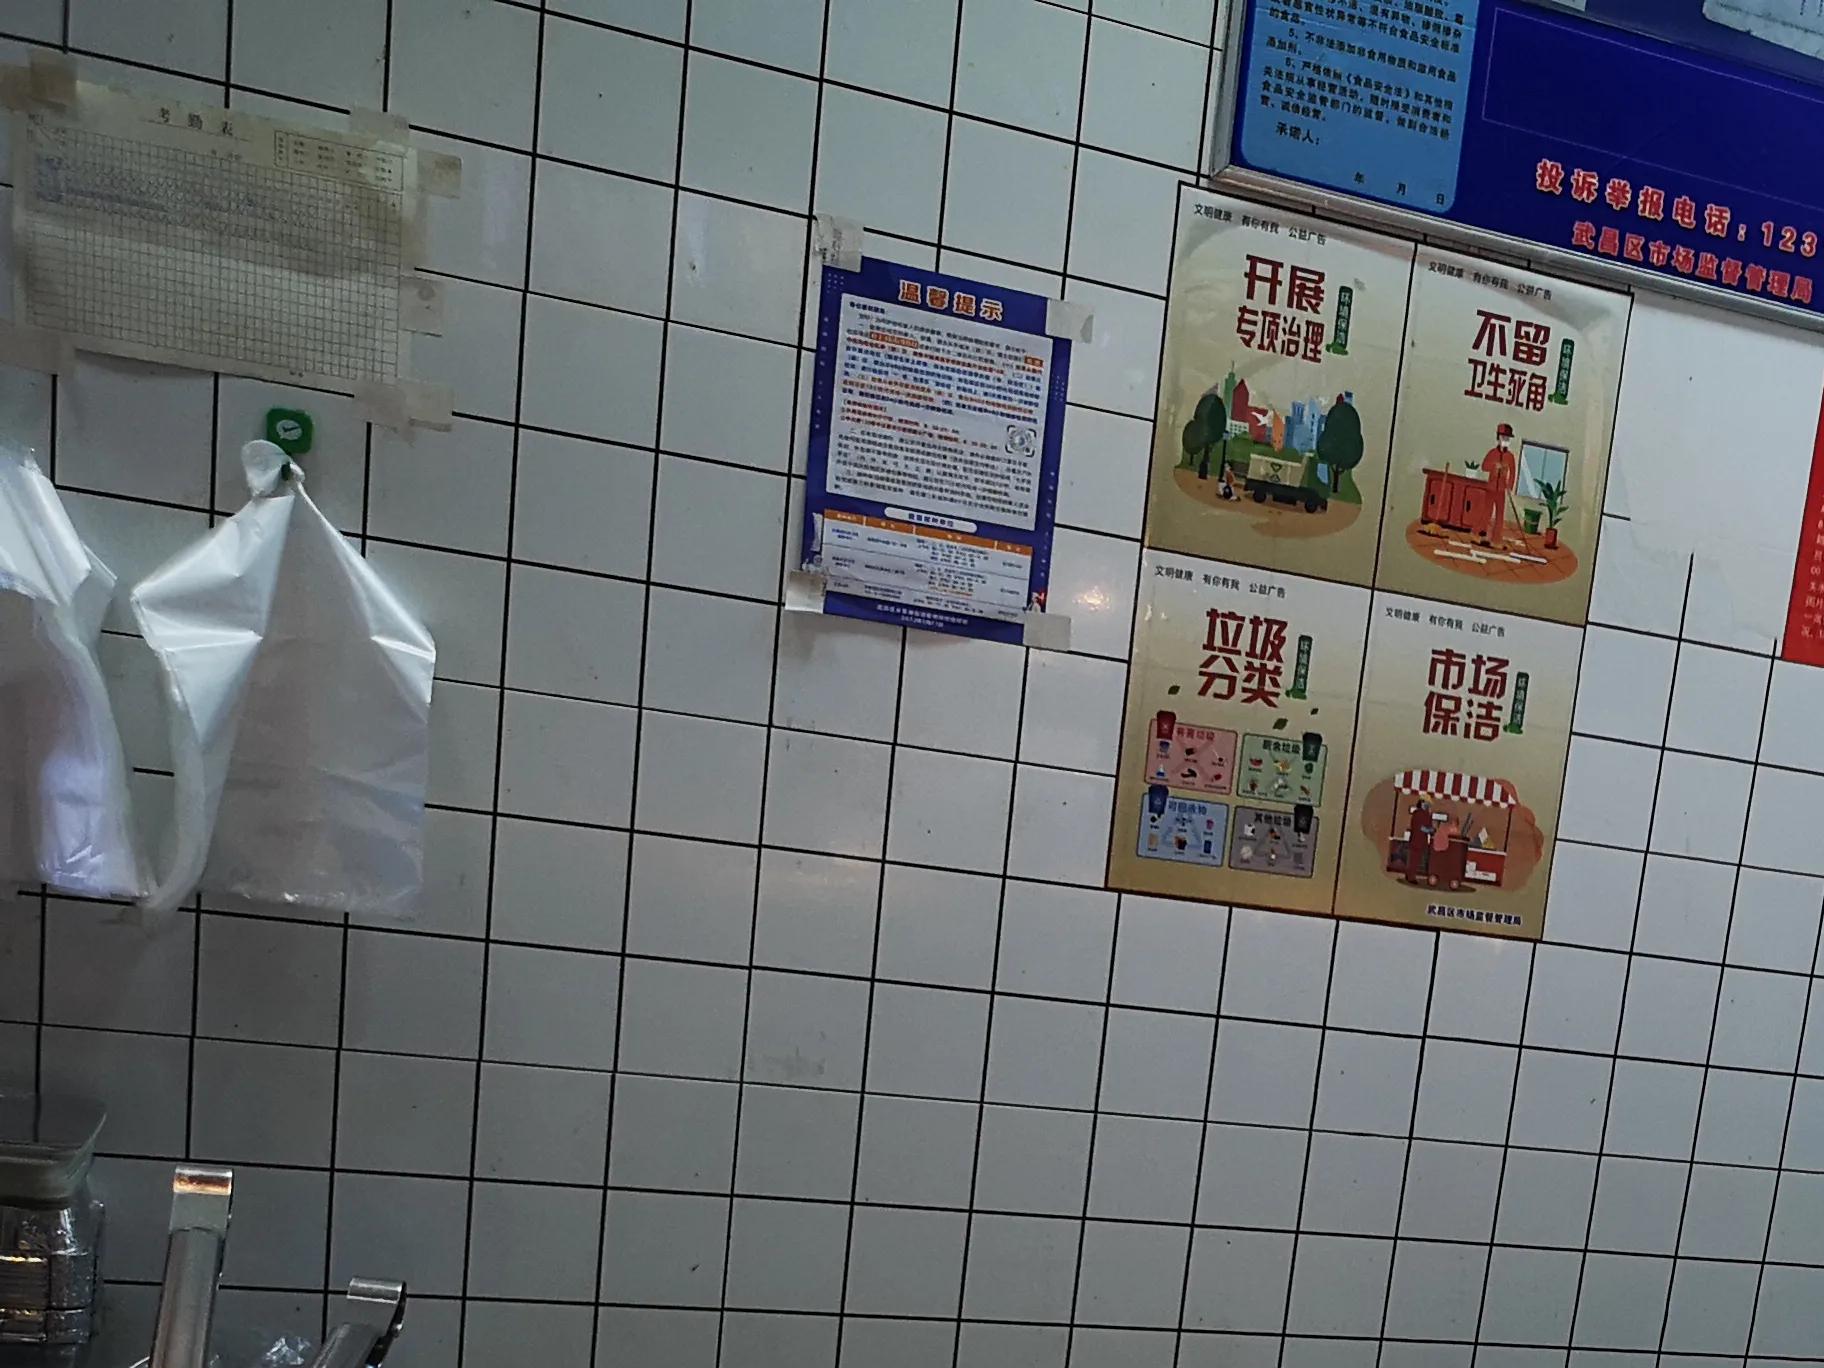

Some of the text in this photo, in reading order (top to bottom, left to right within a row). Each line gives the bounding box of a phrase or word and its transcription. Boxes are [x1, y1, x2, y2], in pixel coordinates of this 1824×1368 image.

[1397, 182, 1406, 195] 月
[1436, 193, 1445, 205] 日
[1193, 203, 1327, 246] 文明健康 有你有我 公益广告
[1243, 253, 1327, 315] 开展
[1428, 260, 1552, 300] 文明健康 有你有我 公益广告
[1571, 220, 1815, 304] 武昌区市场监督管理局
[898, 279, 1004, 322] 温馨提示
[1235, 304, 1325, 364] 专项治理
[1471, 309, 1552, 366] 不留
[1463, 357, 1547, 412] 卫生死角
[1154, 564, 1287, 599] 文明健康 有你有我 公益广告
[1202, 607, 1289, 664] 垃圾
[1385, 606, 1506, 638] 文明健康 有你有我 公益广告
[1197, 654, 1283, 708] 分类
[1428, 648, 1511, 701] 市场
[1421, 691, 1504, 743] 保洁
[1254, 812, 1292, 827] 其他垃圾
[1426, 904, 1522, 926] 武昌区市场监督管理局
